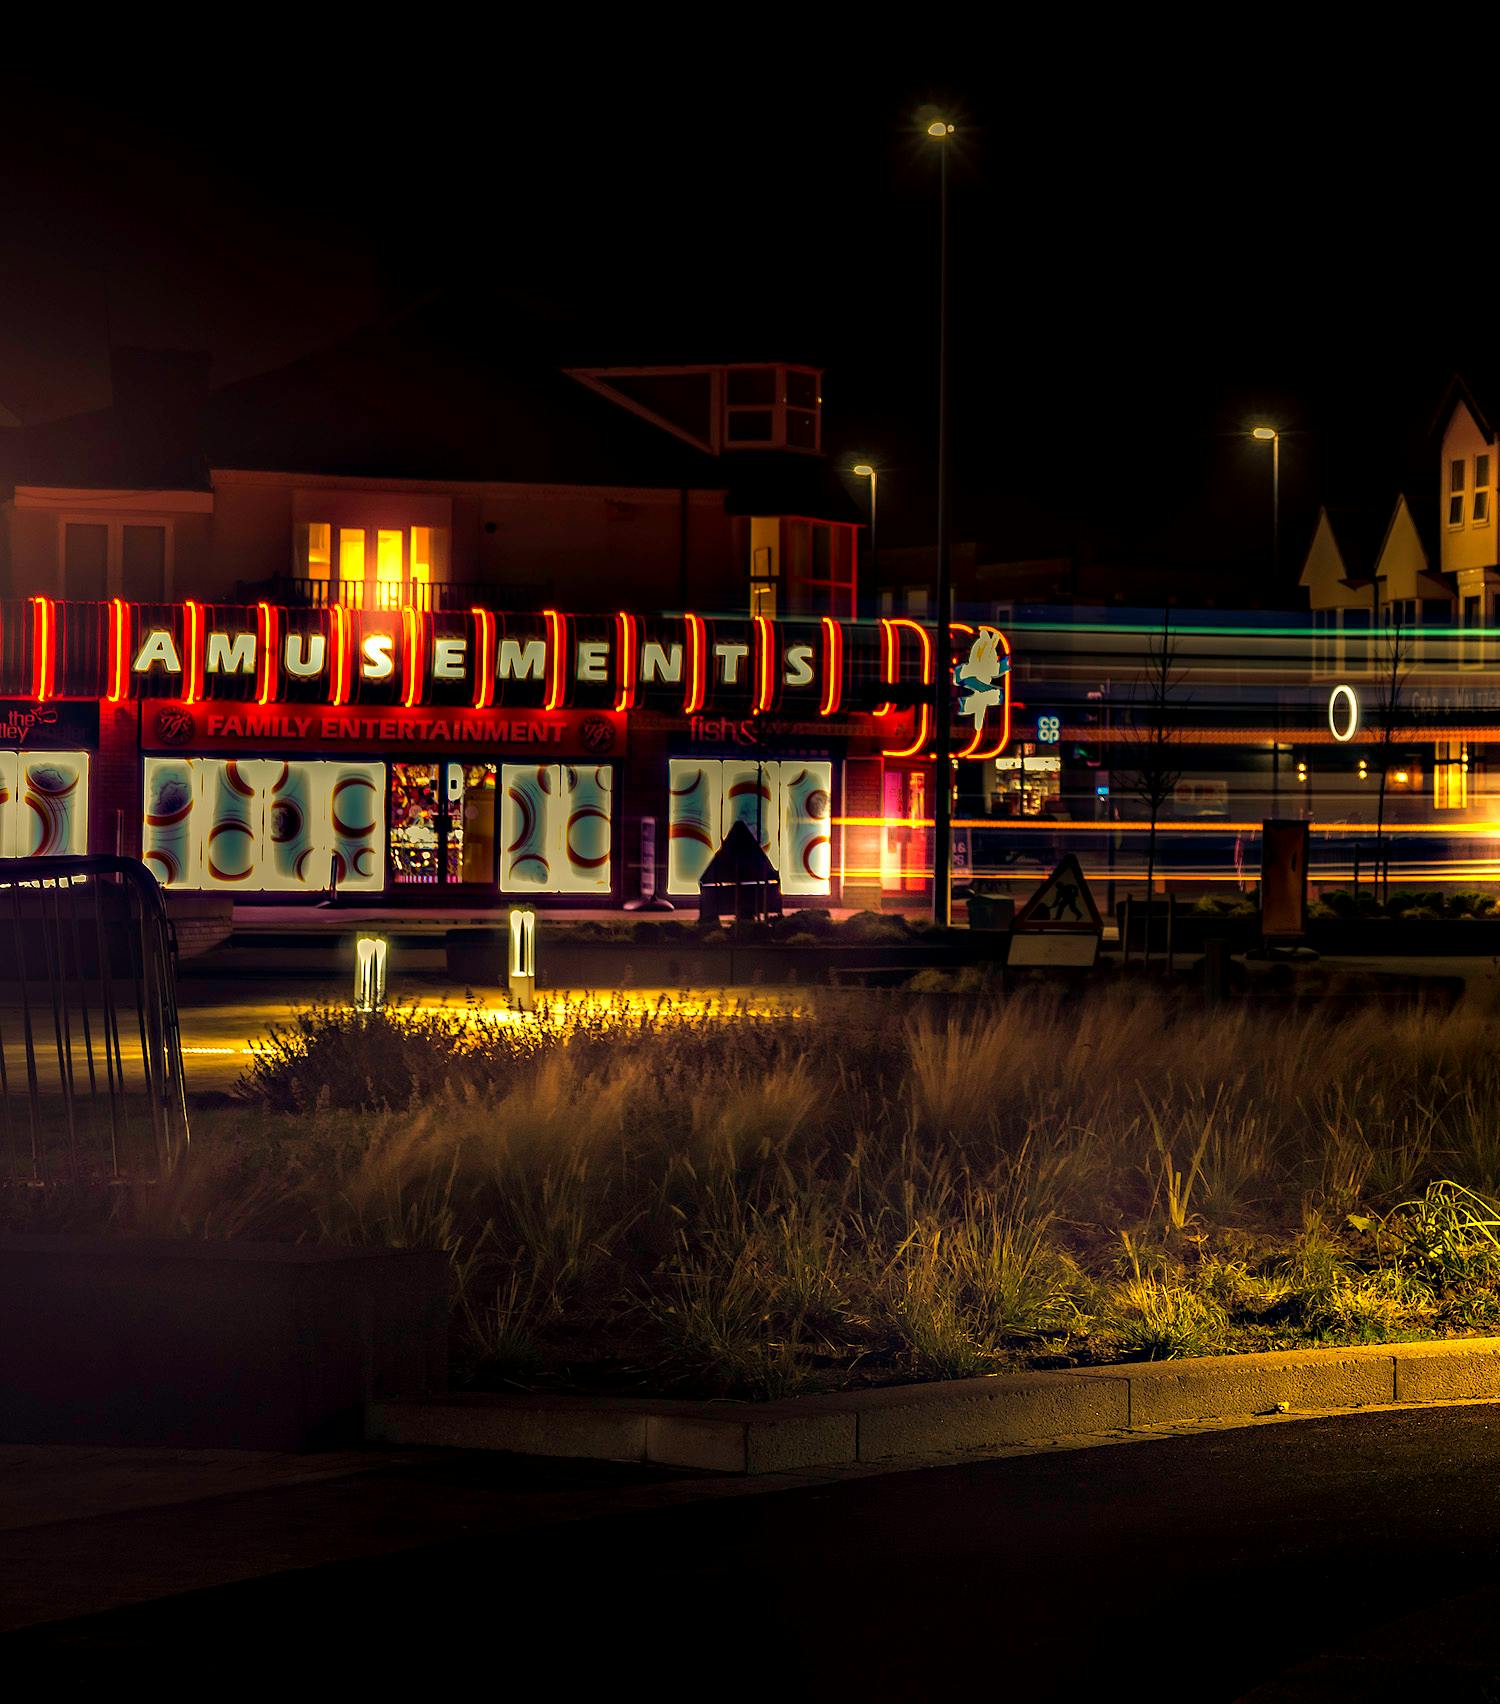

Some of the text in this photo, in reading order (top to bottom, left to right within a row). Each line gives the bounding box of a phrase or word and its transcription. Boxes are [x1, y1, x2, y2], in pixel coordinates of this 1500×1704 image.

[133, 630, 815, 686] AMUSEMENTS
[8, 710, 36, 727] the
[207, 714, 567, 743] FAMILY ENTERTAINMENT
